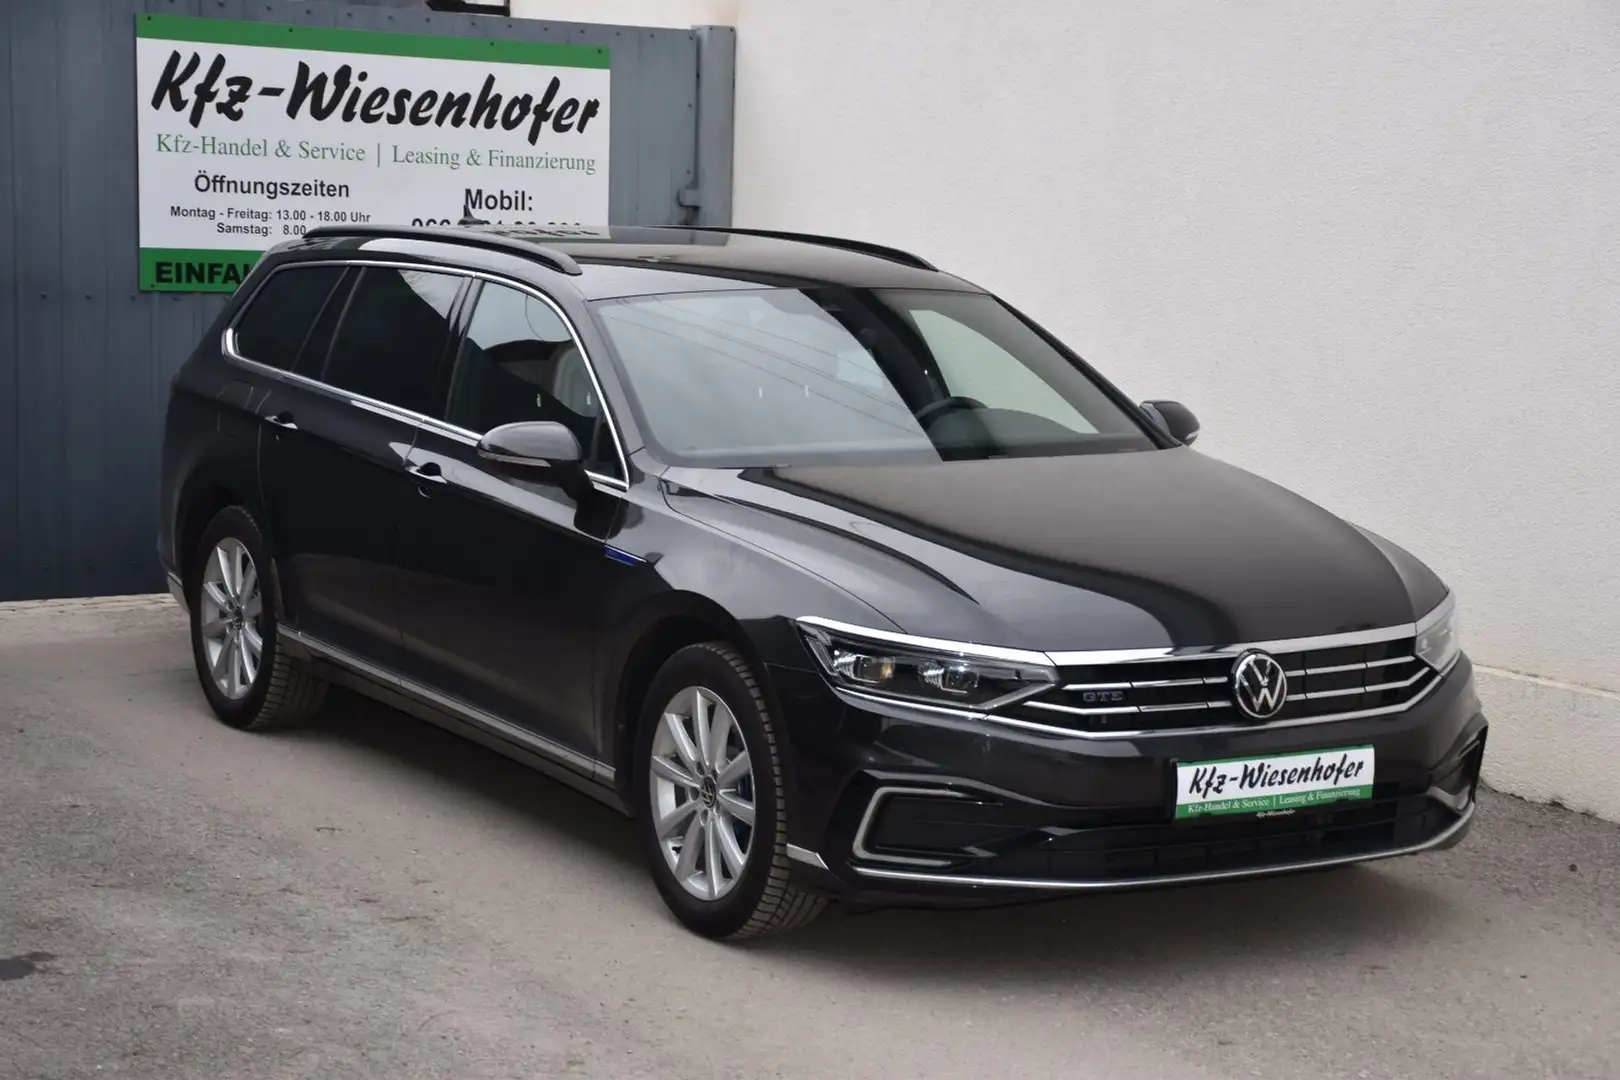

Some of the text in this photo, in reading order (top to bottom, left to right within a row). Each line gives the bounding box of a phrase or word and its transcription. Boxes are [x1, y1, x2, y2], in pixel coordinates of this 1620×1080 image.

[151, 50, 600, 146] Kfz-Wiesenhofer
[156, 134, 267, 157] Kfz-Handel
[274, 140, 291, 158] &
[298, 141, 366, 161] Service
[392, 145, 460, 169] Leasing
[466, 149, 481, 167] &
[488, 150, 596, 175] Finanzierung
[194, 170, 350, 200] Öffnungszeiten
[465, 188, 533, 211] Mobil:
[170, 206, 216, 220] Montag
[227, 208, 273, 222] Freitag:
[276, 210, 306, 221] 13.00
[318, 211, 347, 222] 18.00
[350, 213, 371, 223] Uhr
[217, 223, 273, 236] Samstag:
[1189, 753, 1365, 799] Kfz-Wiesenhofer
